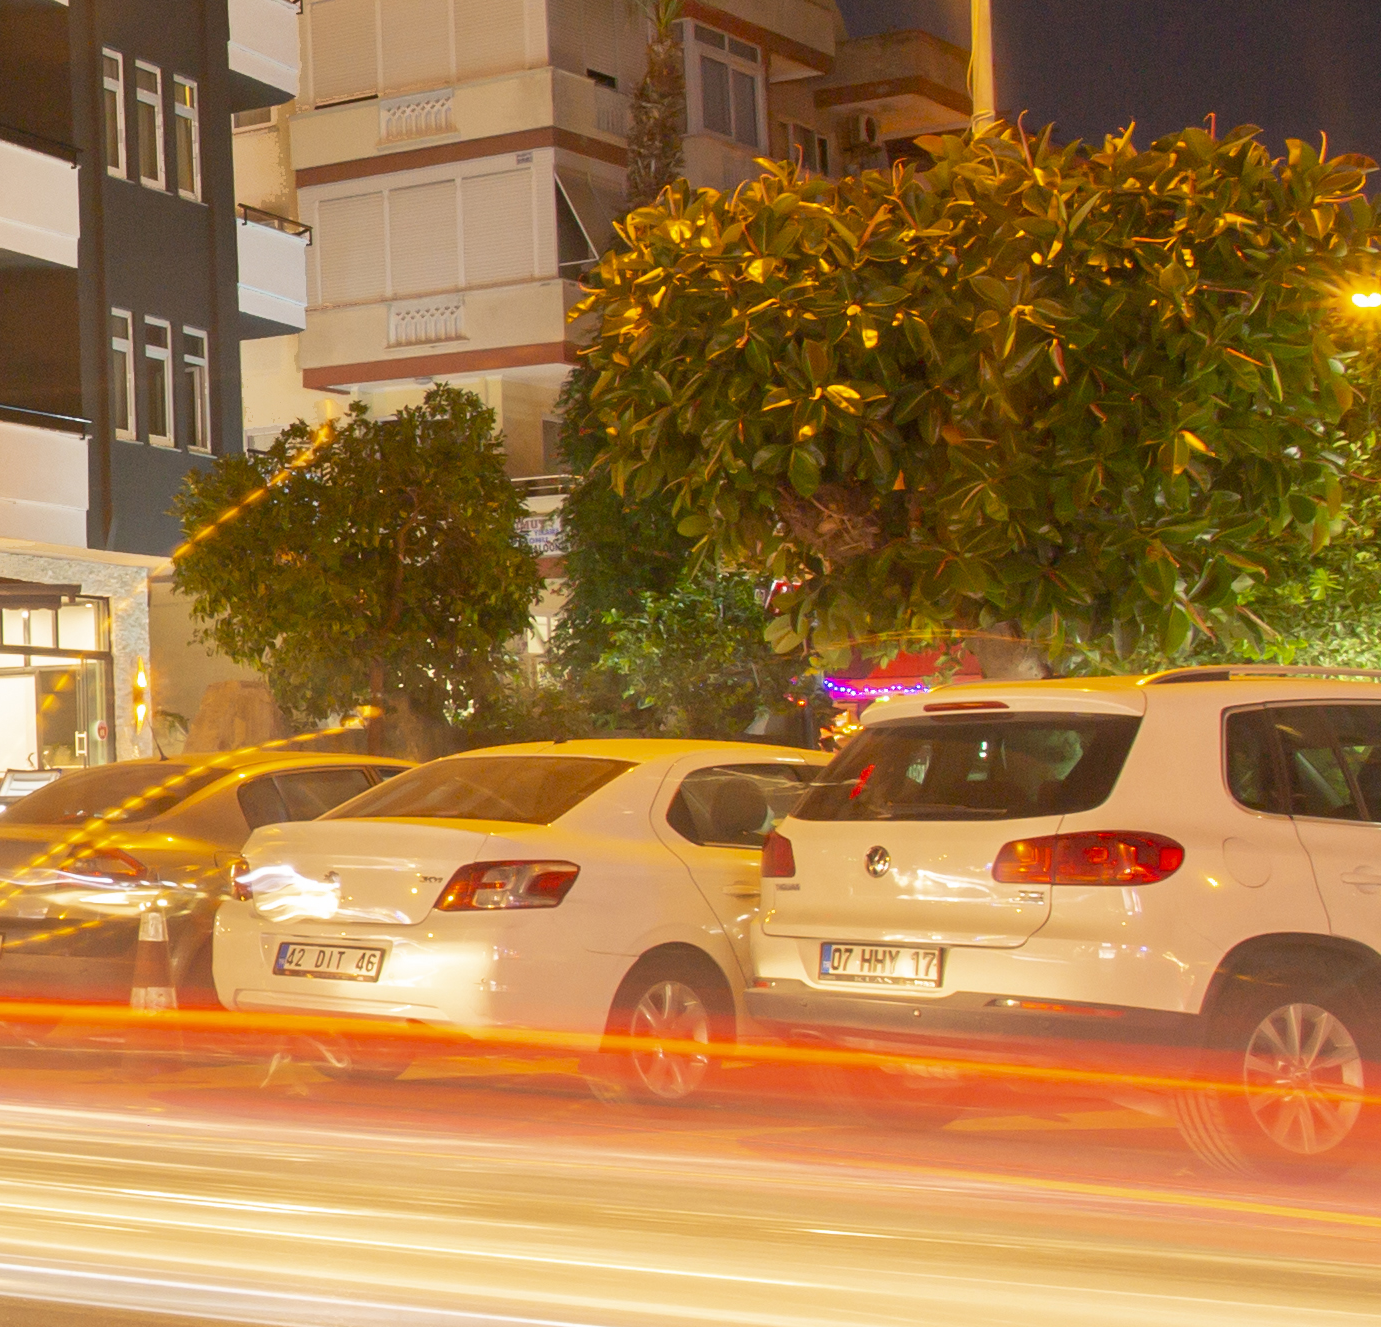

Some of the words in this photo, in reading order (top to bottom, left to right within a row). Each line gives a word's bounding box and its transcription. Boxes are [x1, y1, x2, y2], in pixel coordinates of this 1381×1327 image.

[286, 948, 306, 967] 42
[314, 950, 345, 970] DIT
[355, 953, 377, 972] 46
[831, 947, 854, 971] 07
[859, 948, 900, 974] HHY
[910, 951, 936, 977] 17
